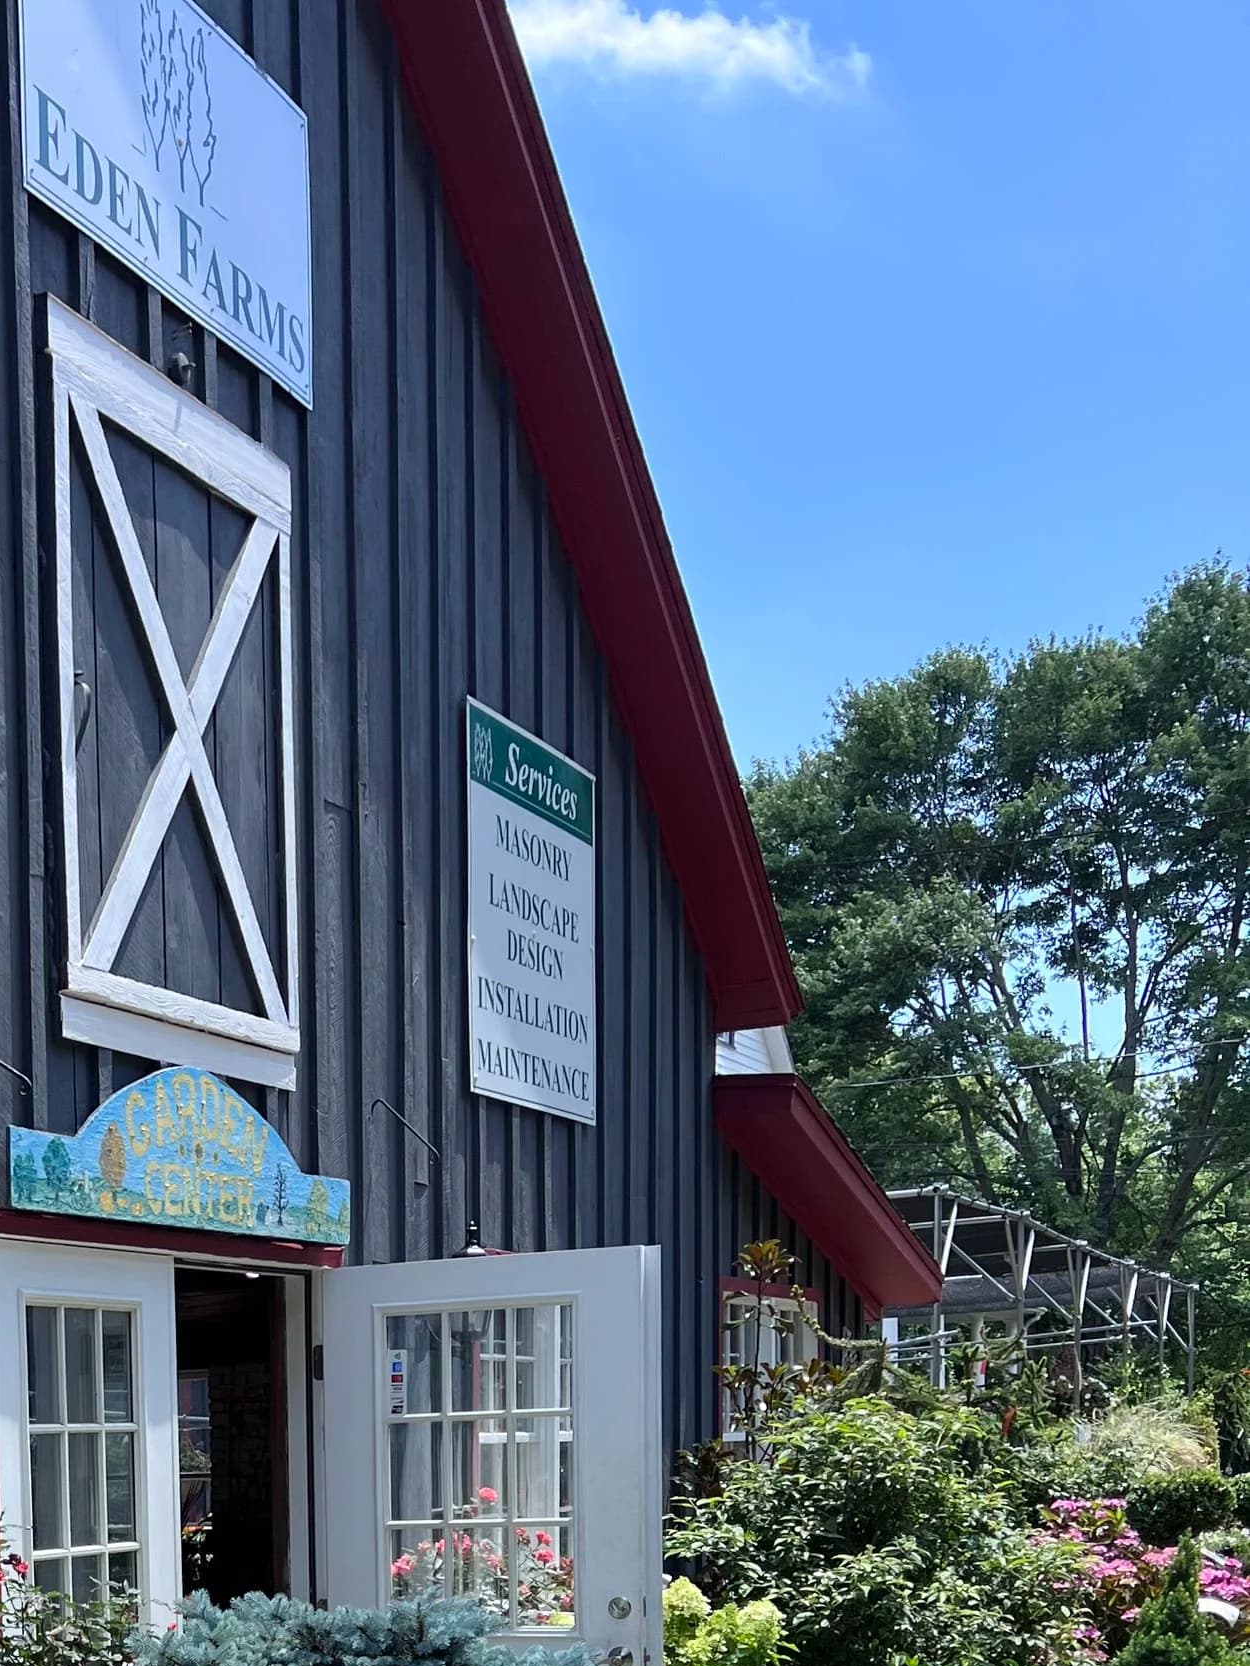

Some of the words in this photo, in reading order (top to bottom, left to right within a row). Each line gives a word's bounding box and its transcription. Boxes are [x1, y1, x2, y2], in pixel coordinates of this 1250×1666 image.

[33, 84, 161, 260] EDEN
[175, 205, 304, 373] FARMS
[504, 742, 578, 820] Services
[495, 814, 572, 883] MASONRY
[489, 872, 579, 944] LANDSCAPE
[507, 928, 564, 981] DESIGN
[477, 975, 588, 1044] INSTALLATION
[477, 1037, 590, 1102] MAINTENANCE
[125, 1073, 269, 1178] GARDEN
[145, 1161, 254, 1228] CENTER
